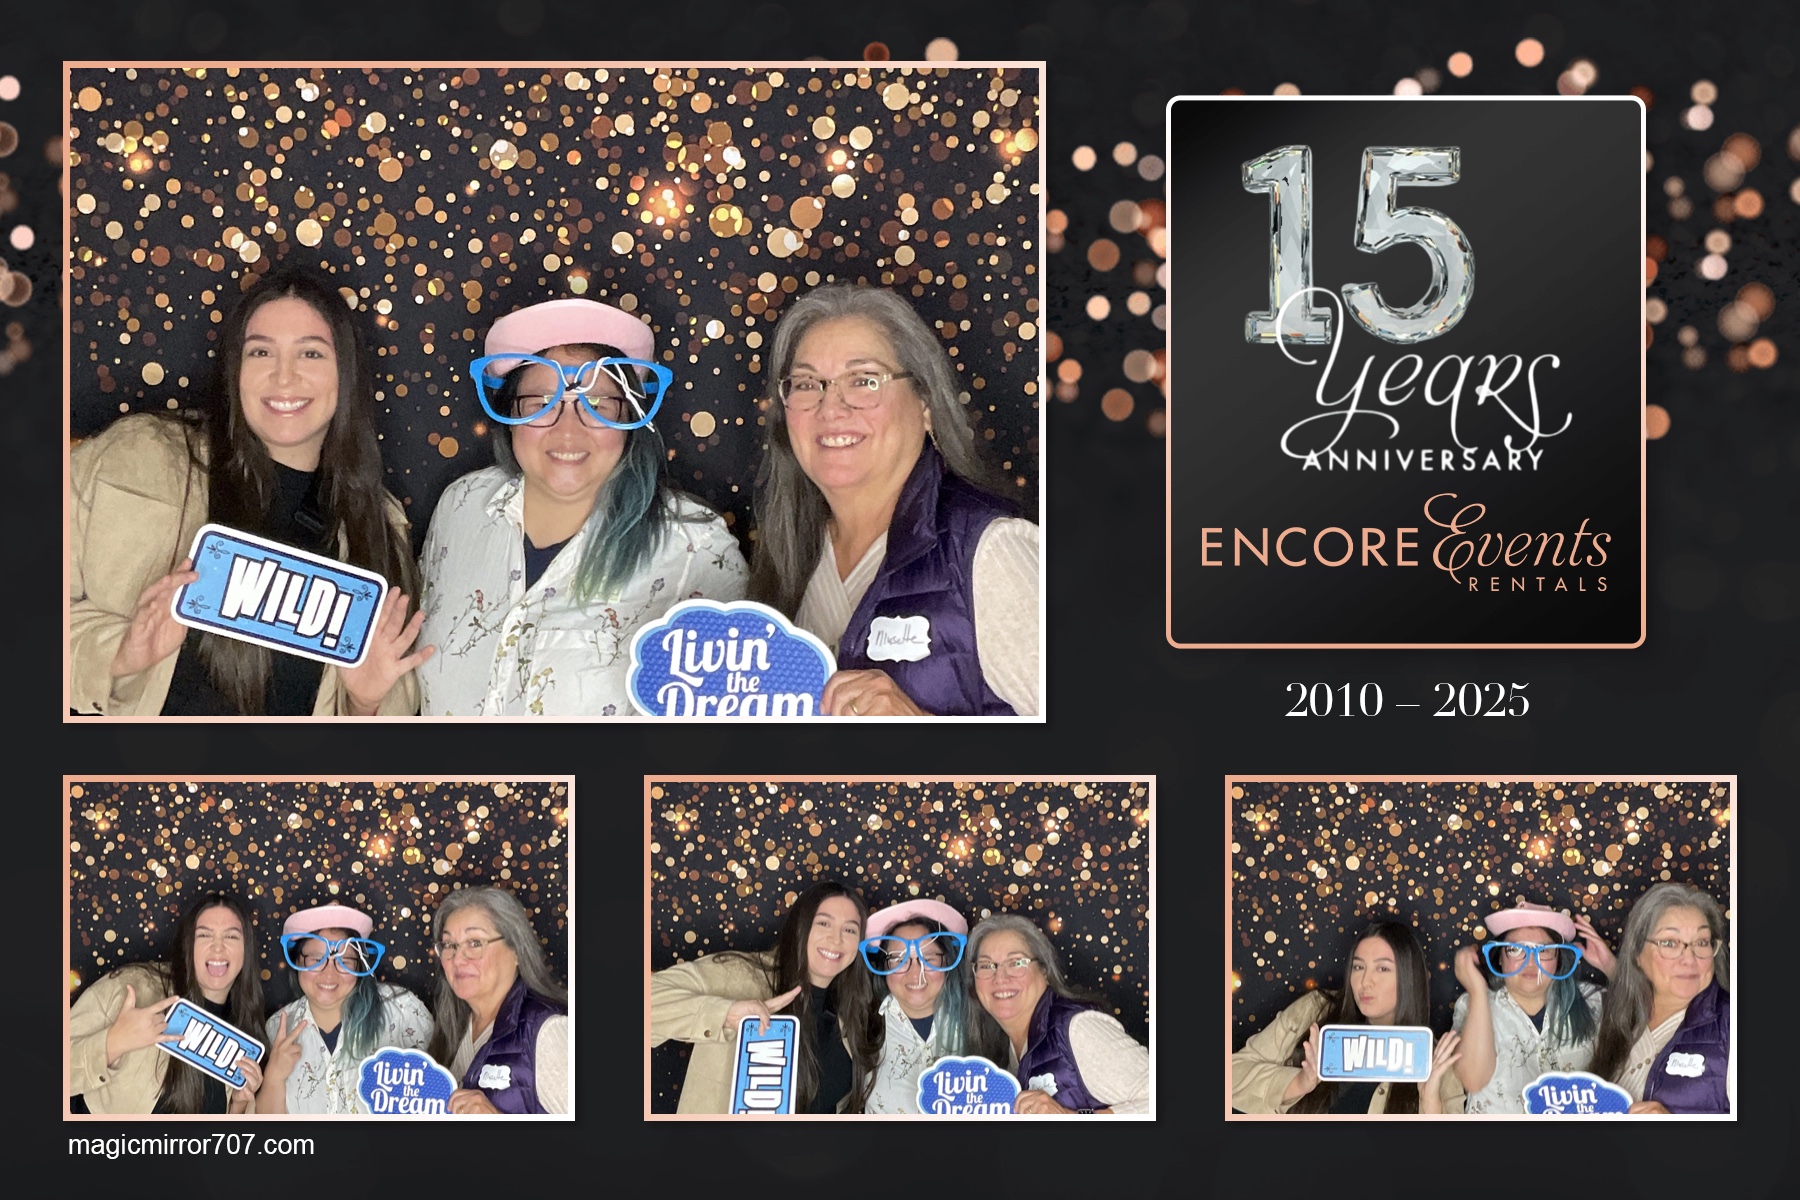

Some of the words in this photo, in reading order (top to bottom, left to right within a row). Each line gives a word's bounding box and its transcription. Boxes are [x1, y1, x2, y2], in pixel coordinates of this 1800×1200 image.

[219, 553, 354, 650] WILD!
[662, 623, 776, 688] Livin'
[657, 681, 814, 716] Dream
[726, 671, 760, 693] the
[177, 1016, 247, 1078] WILD!
[1342, 1034, 1414, 1075] WILD!
[373, 1060, 428, 1092] Livin'
[403, 1085, 420, 1097] the
[933, 1067, 989, 1102] Livin'
[370, 1088, 446, 1114] Dream
[966, 1092, 983, 1104] the
[1538, 1082, 1598, 1111] Livin'
